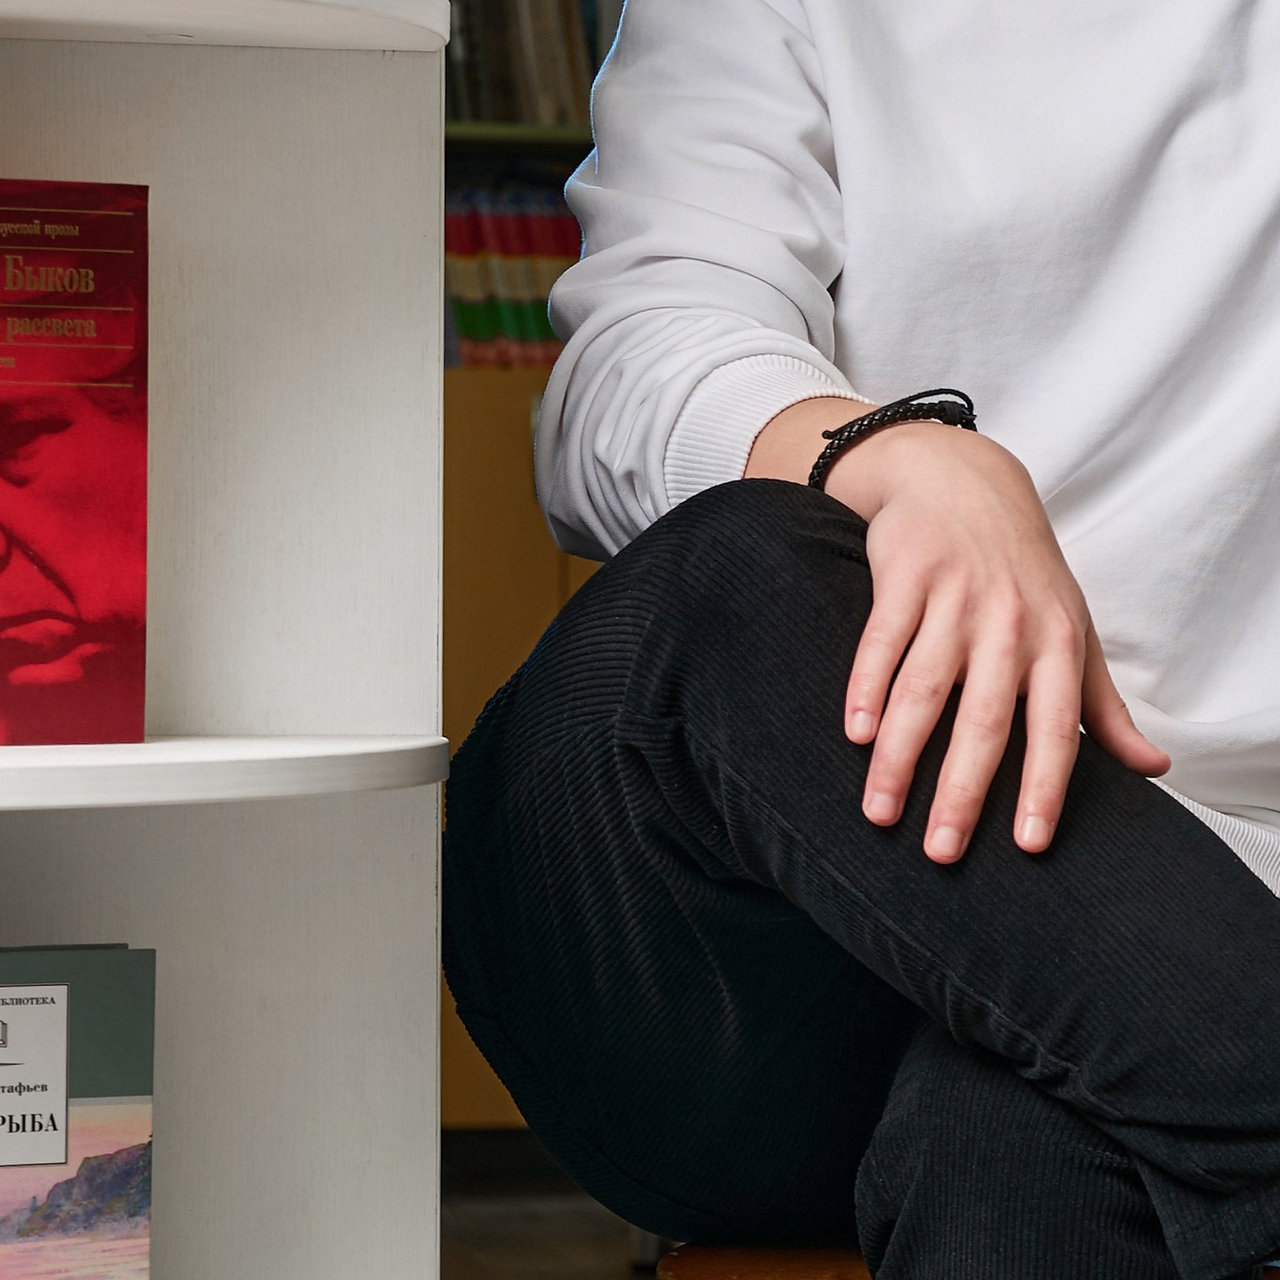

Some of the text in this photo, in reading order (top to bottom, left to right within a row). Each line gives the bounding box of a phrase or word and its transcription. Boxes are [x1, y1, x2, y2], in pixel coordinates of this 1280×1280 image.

[45, 224, 79, 239] прозы
[4, 255, 96, 294] Быков
[6, 317, 97, 343] рассвета
[0, 997, 56, 1006] БЛИОТЕКА
